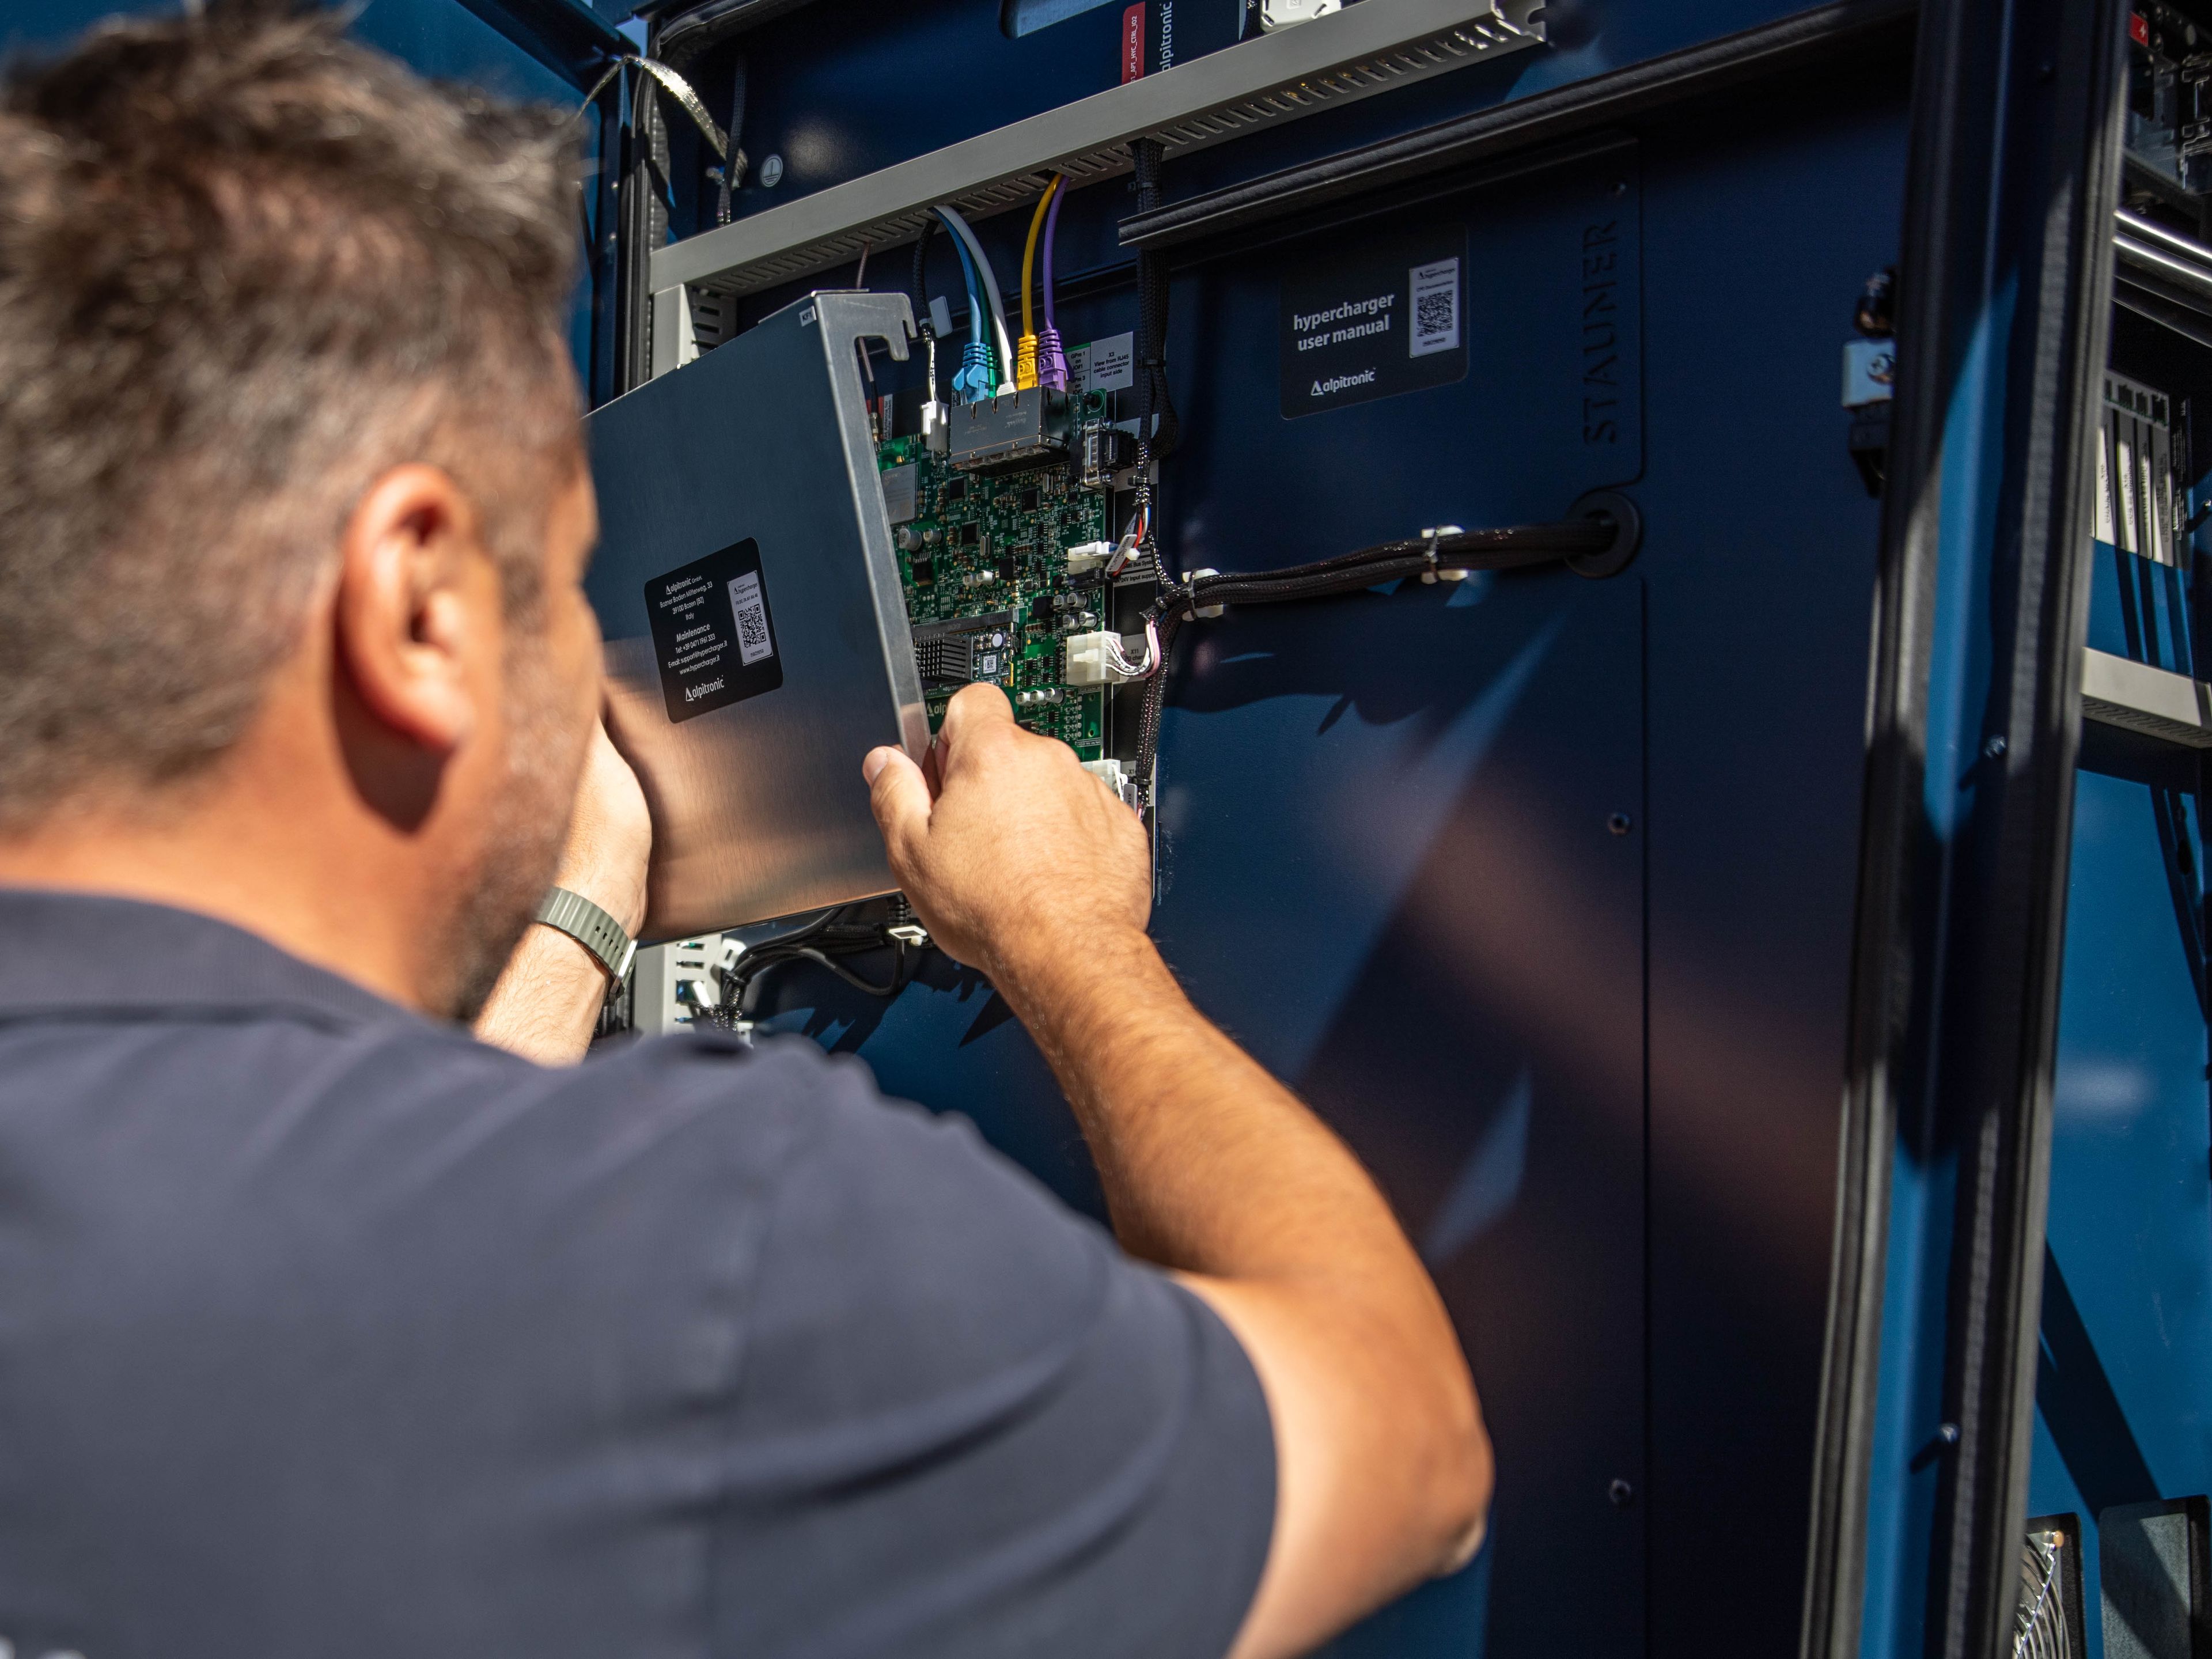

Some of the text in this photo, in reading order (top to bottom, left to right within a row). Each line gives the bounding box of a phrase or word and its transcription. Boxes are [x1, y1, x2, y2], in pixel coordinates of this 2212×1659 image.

[1293, 294, 1395, 332] hypercharger
[1297, 313, 1390, 351] user manual
[1107, 361, 1130, 370] connector
[1322, 370, 1376, 393] alpitronic
[671, 577, 692, 592] alpitronic
[1141, 572, 1156, 580] supply
[660, 599, 673, 608] Bozner
[673, 593, 686, 603] Boden
[672, 604, 684, 615] 39100
[684, 601, 696, 609] Bozen
[685, 612, 694, 621] Italy
[676, 624, 710, 642] Maintenance
[680, 640, 728, 664] support@hypercharger.it
[679, 654, 720, 675] www.hypercharger.it
[692, 677, 725, 699] alpitronic
